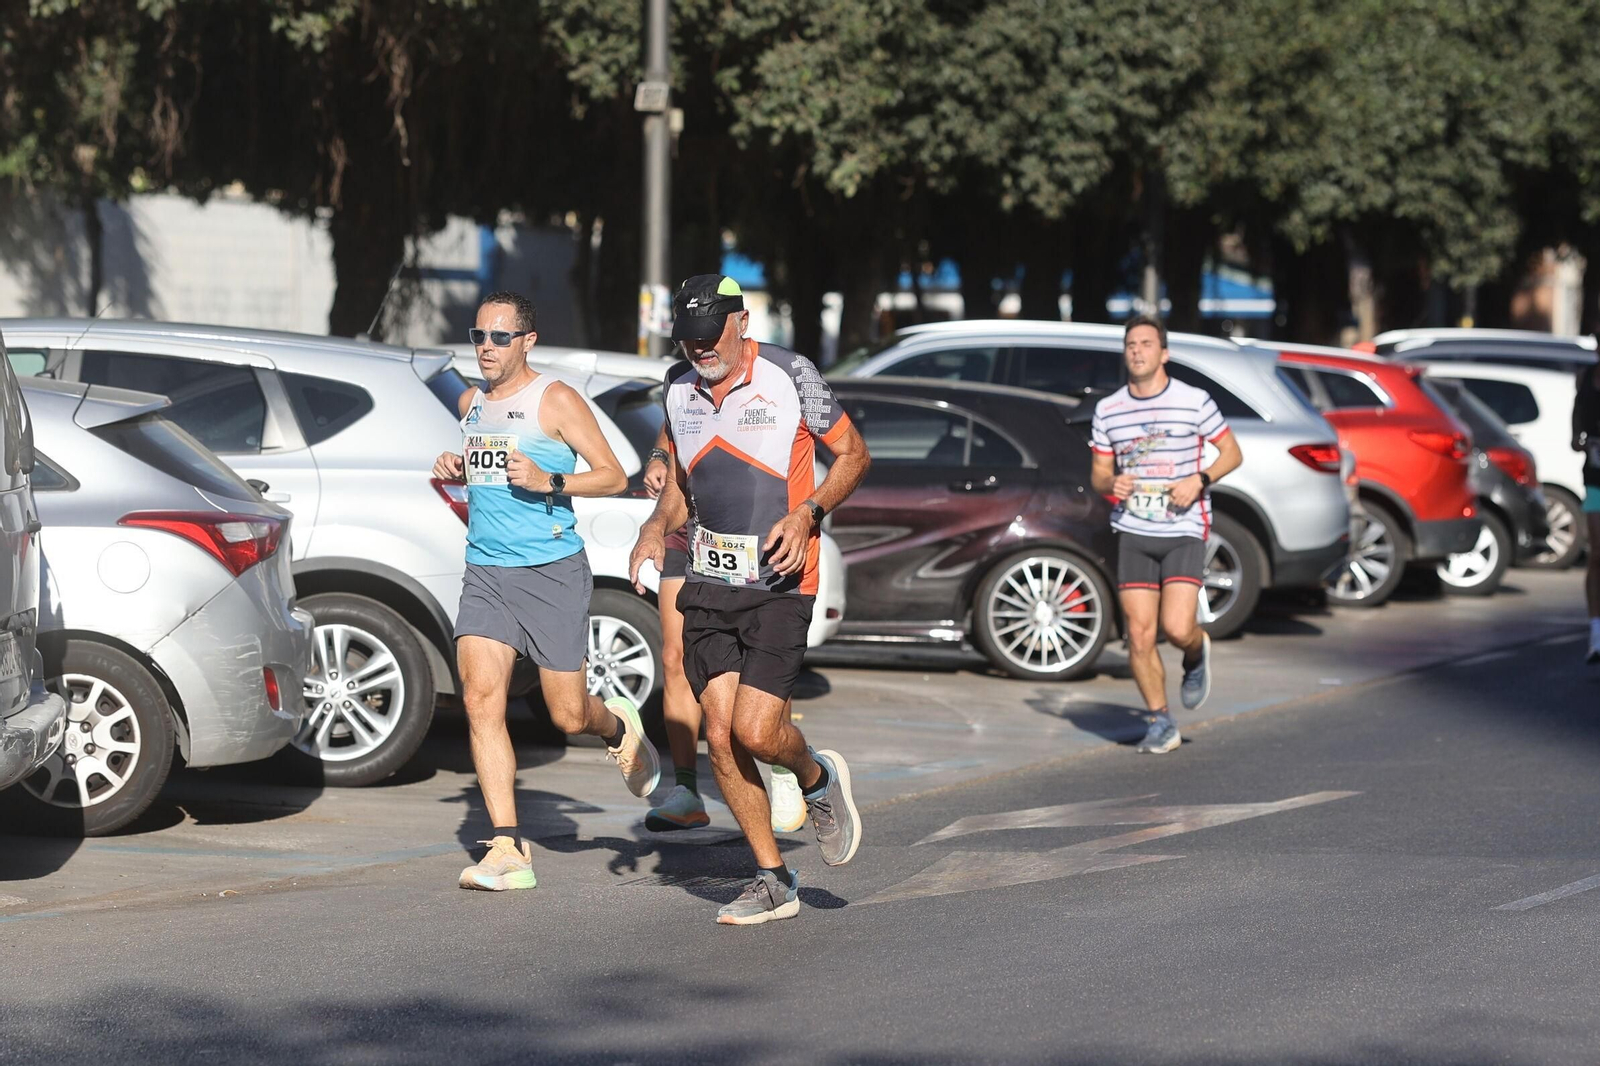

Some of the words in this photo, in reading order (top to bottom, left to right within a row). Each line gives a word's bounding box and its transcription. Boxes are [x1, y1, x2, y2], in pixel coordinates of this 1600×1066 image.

[744, 408, 767, 417] FUENTE
[744, 416, 776, 425] ACEBUCHE
[469, 450, 508, 469] 403
[1133, 495, 1165, 507] 171
[722, 541, 745, 549] 2025
[708, 550, 737, 570] 93
